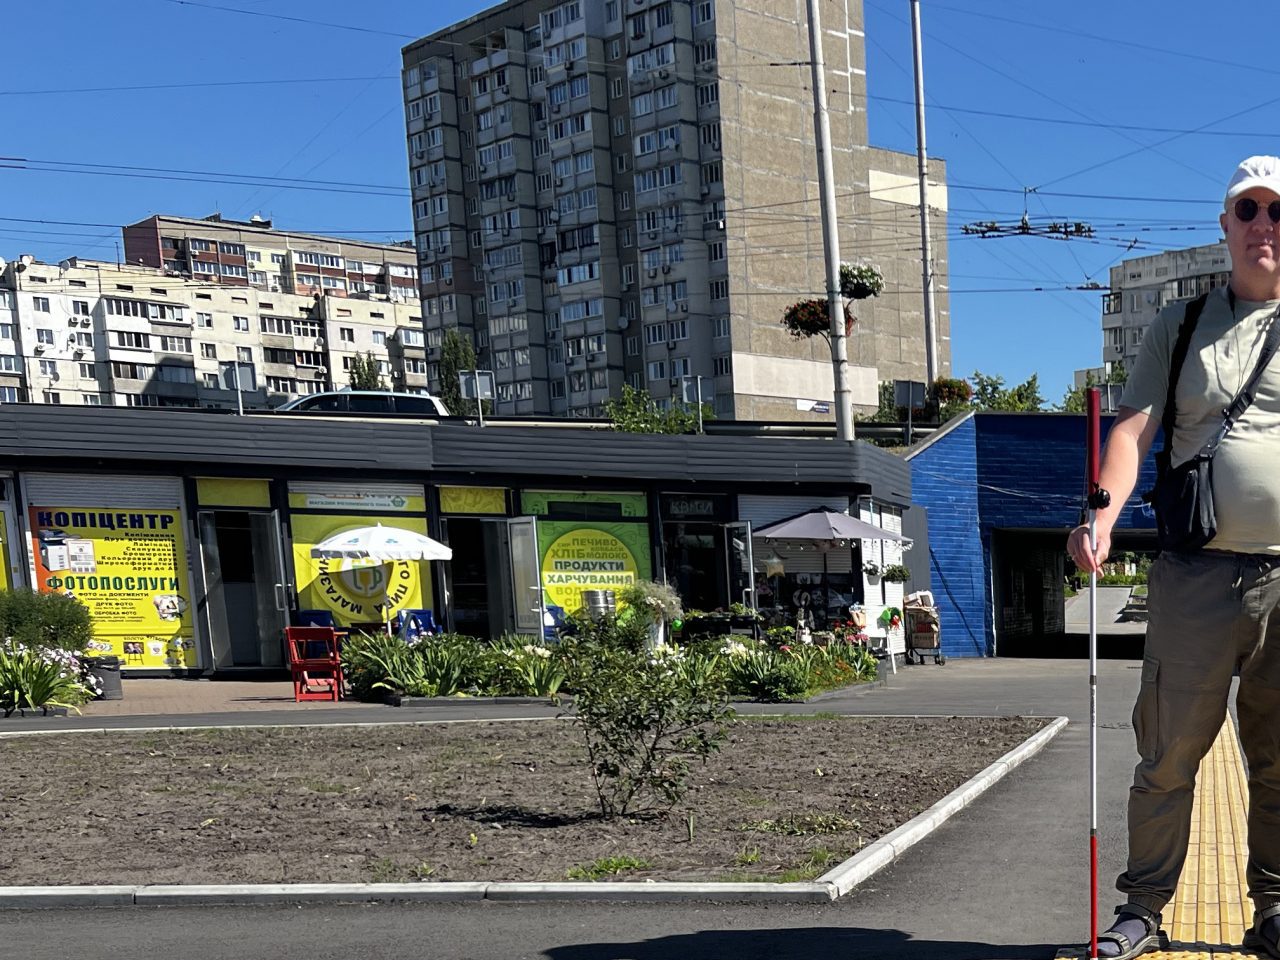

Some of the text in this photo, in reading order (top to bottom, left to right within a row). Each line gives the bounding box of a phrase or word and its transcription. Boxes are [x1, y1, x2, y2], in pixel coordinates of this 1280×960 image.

[37, 511, 174, 530] КОПІЦЕНТР
[572, 538, 618, 547] ПЕЧИВО
[551, 548, 628, 559] ХЛІБ МОЛОКО
[554, 561, 624, 571] ПРОДУКТИ
[46, 575, 180, 591] ФОТОПОСЛУГИ
[547, 574, 633, 585] ХАРЧУВАННЯ
